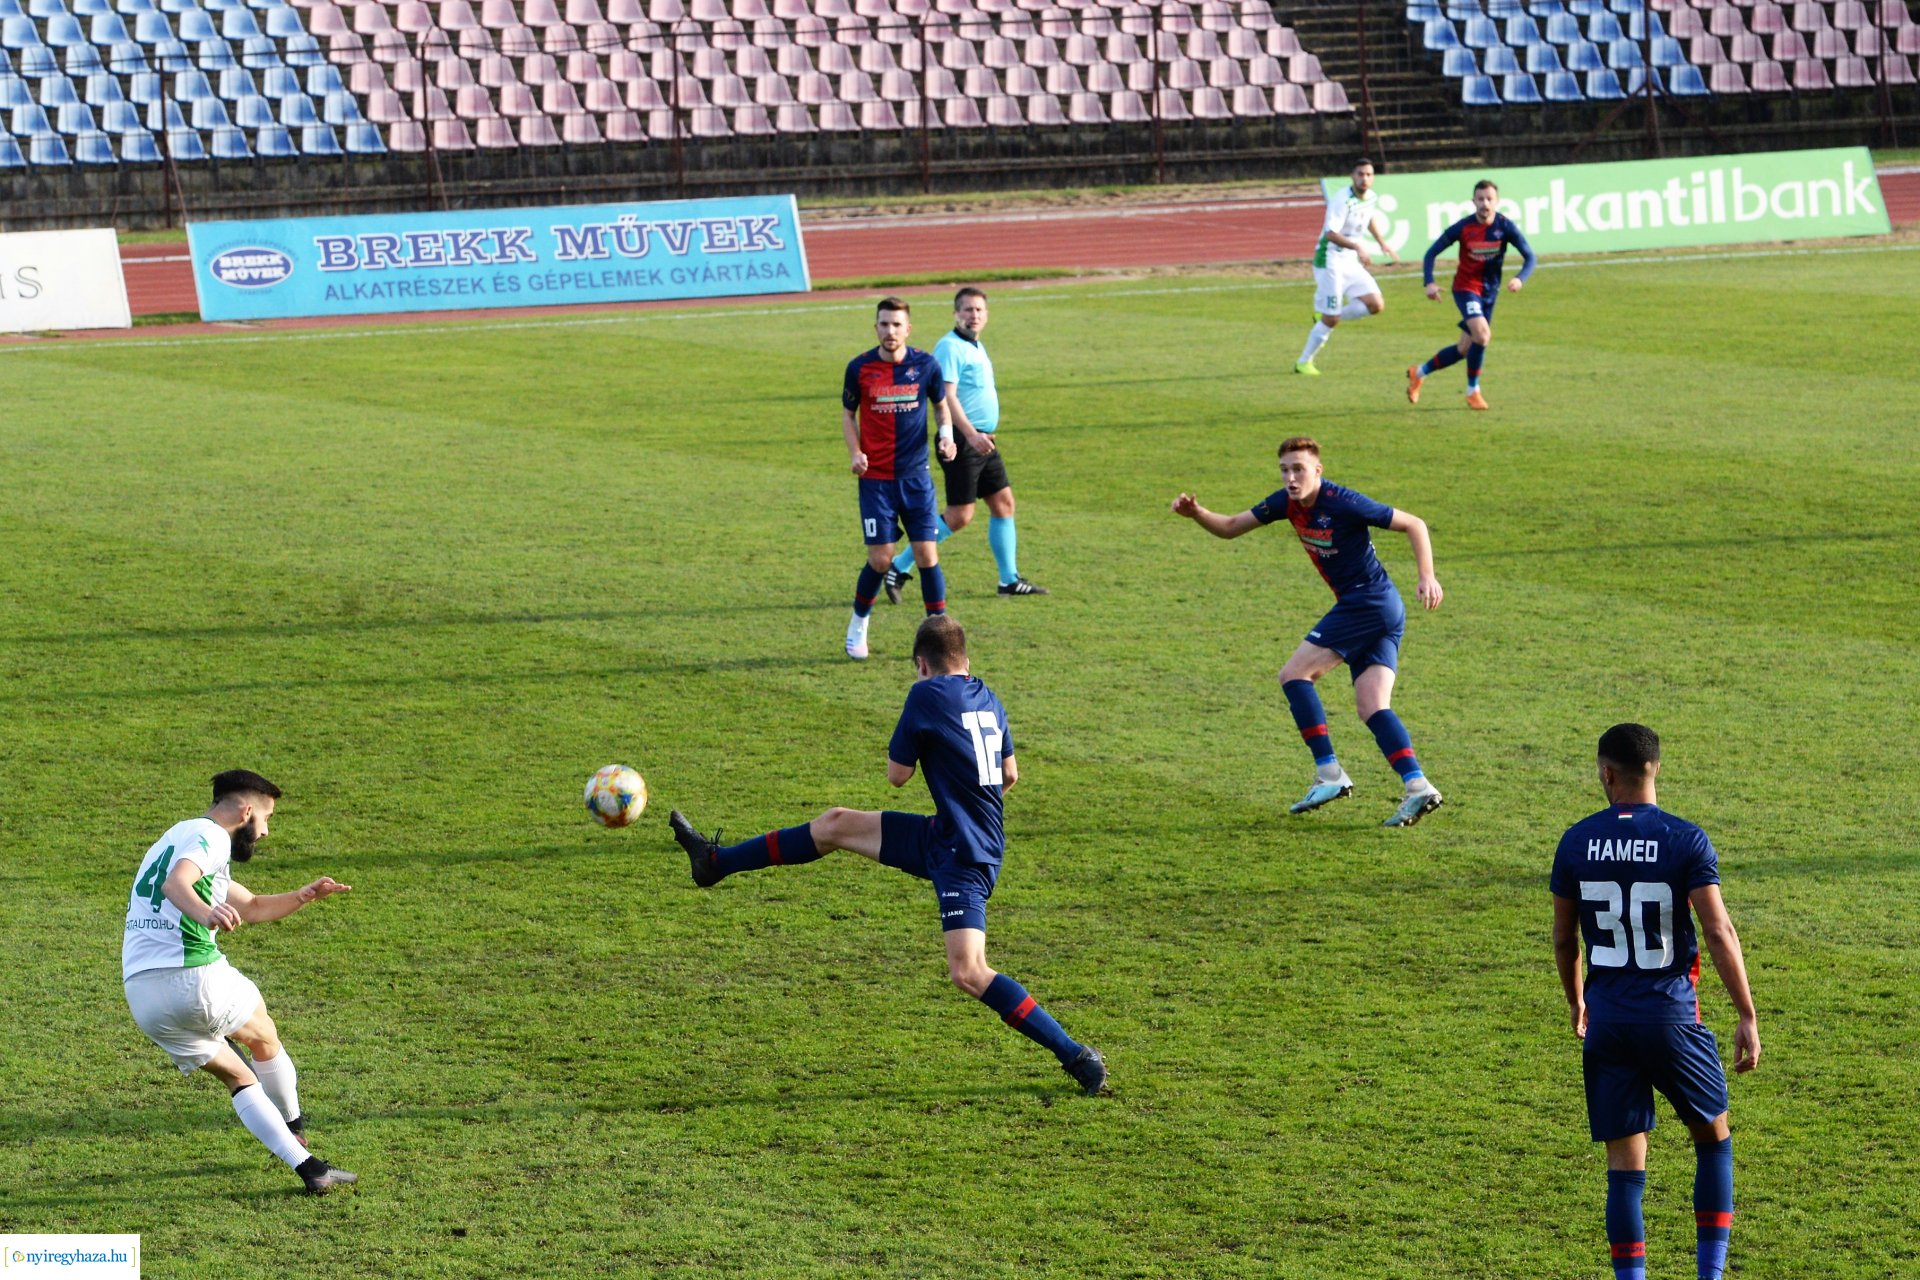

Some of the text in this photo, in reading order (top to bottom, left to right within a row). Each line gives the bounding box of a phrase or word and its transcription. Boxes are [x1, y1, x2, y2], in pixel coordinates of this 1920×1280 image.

[219, 254, 285, 268] BREKK
[315, 228, 537, 271] BREKK
[550, 214, 784, 260] MŰVEK
[324, 260, 790, 301] ALKATRÉSZEK ÉS GÉPELEMEK GYÁRTÁSA
[864, 518, 877, 537] 10
[961, 711, 1003, 786] 12
[1587, 839, 1658, 862] HAMED
[1580, 881, 1674, 969] 30
